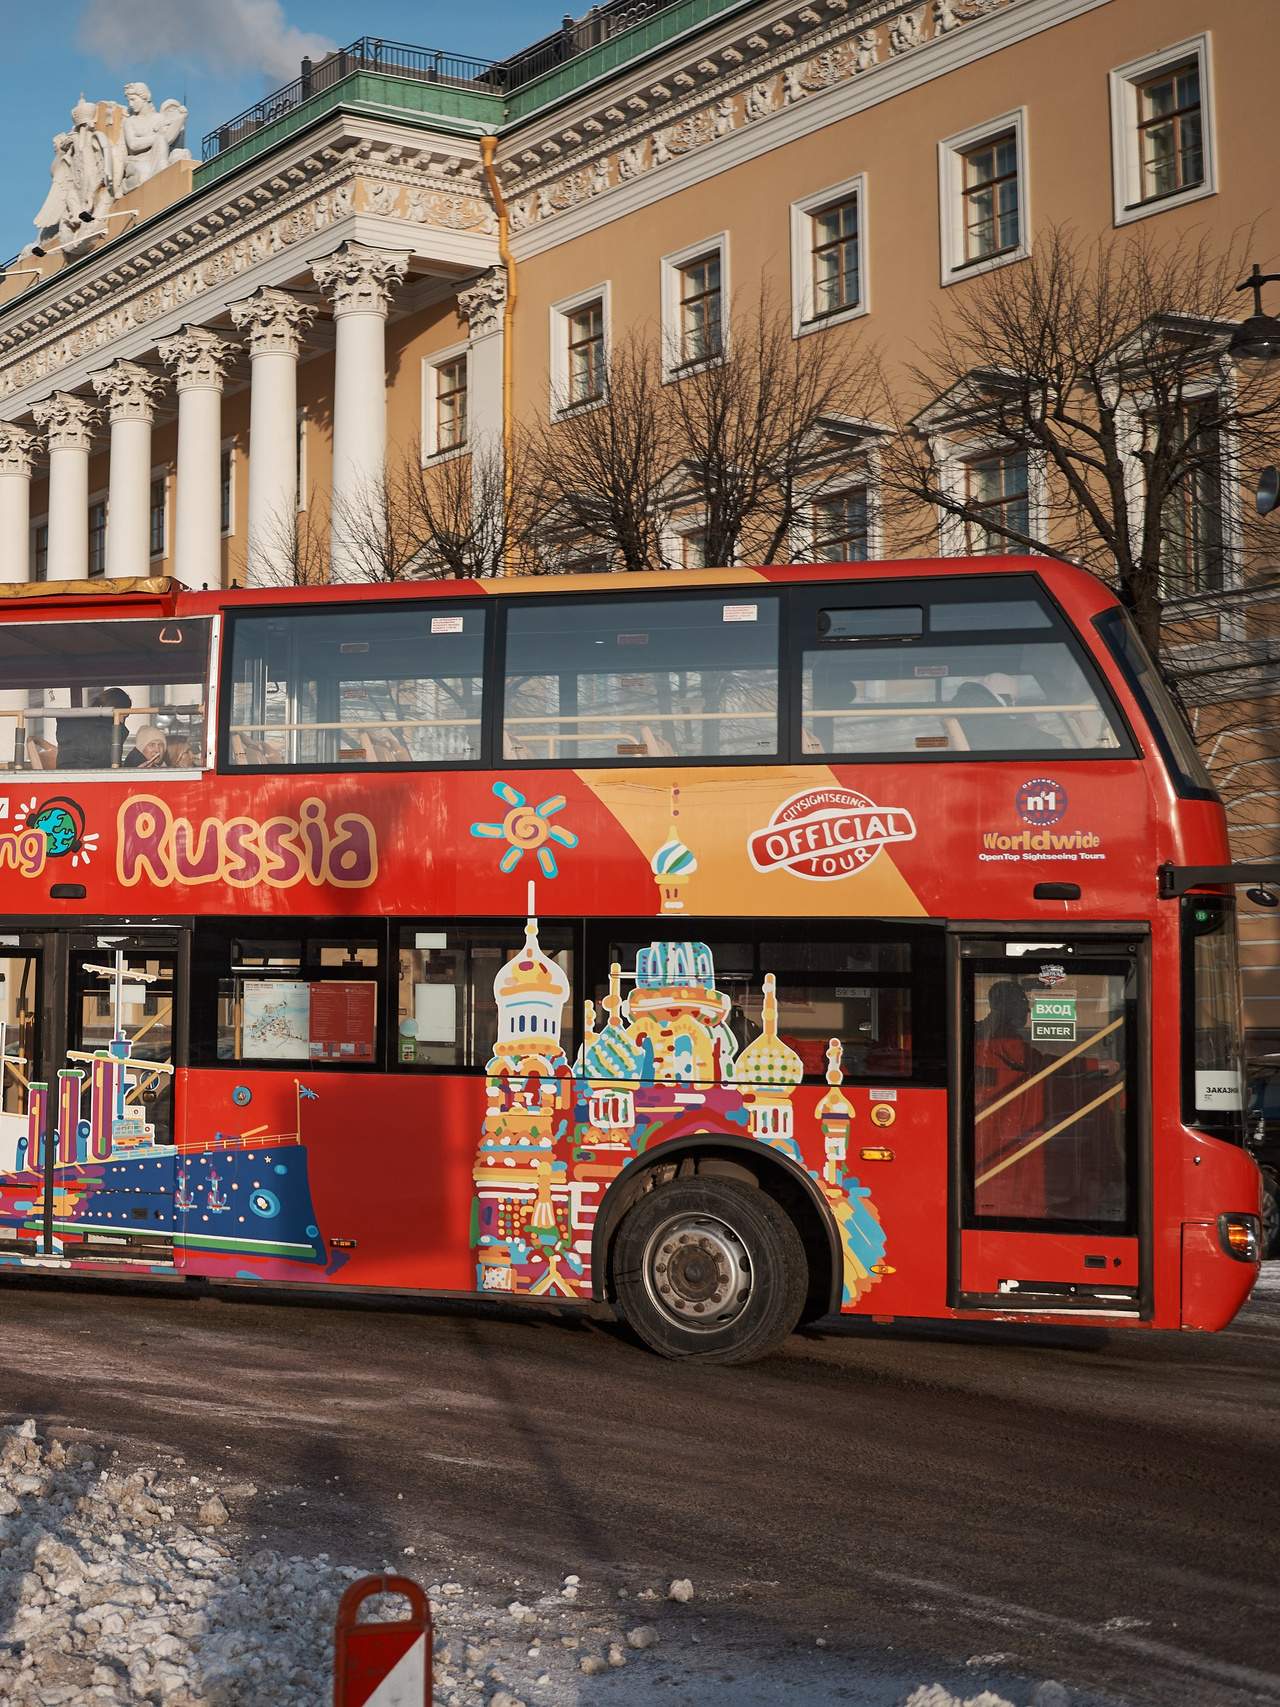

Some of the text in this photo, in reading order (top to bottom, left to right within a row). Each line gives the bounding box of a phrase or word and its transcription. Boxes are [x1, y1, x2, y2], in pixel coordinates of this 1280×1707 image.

[1022, 779, 1060, 789] Operador
[782, 793, 866, 822] CITYSIGHTSEEING
[1022, 816, 1059, 826] Operator
[116, 794, 378, 888] Russia
[765, 813, 905, 860] OFFICIAL
[983, 830, 1100, 850] Worldwide
[810, 847, 871, 874] TOUR
[979, 852, 1106, 861] OpenTop Sightseeing Tours
[1035, 1004, 1072, 1016] ВХОД
[1036, 1026, 1071, 1036] ENTER
